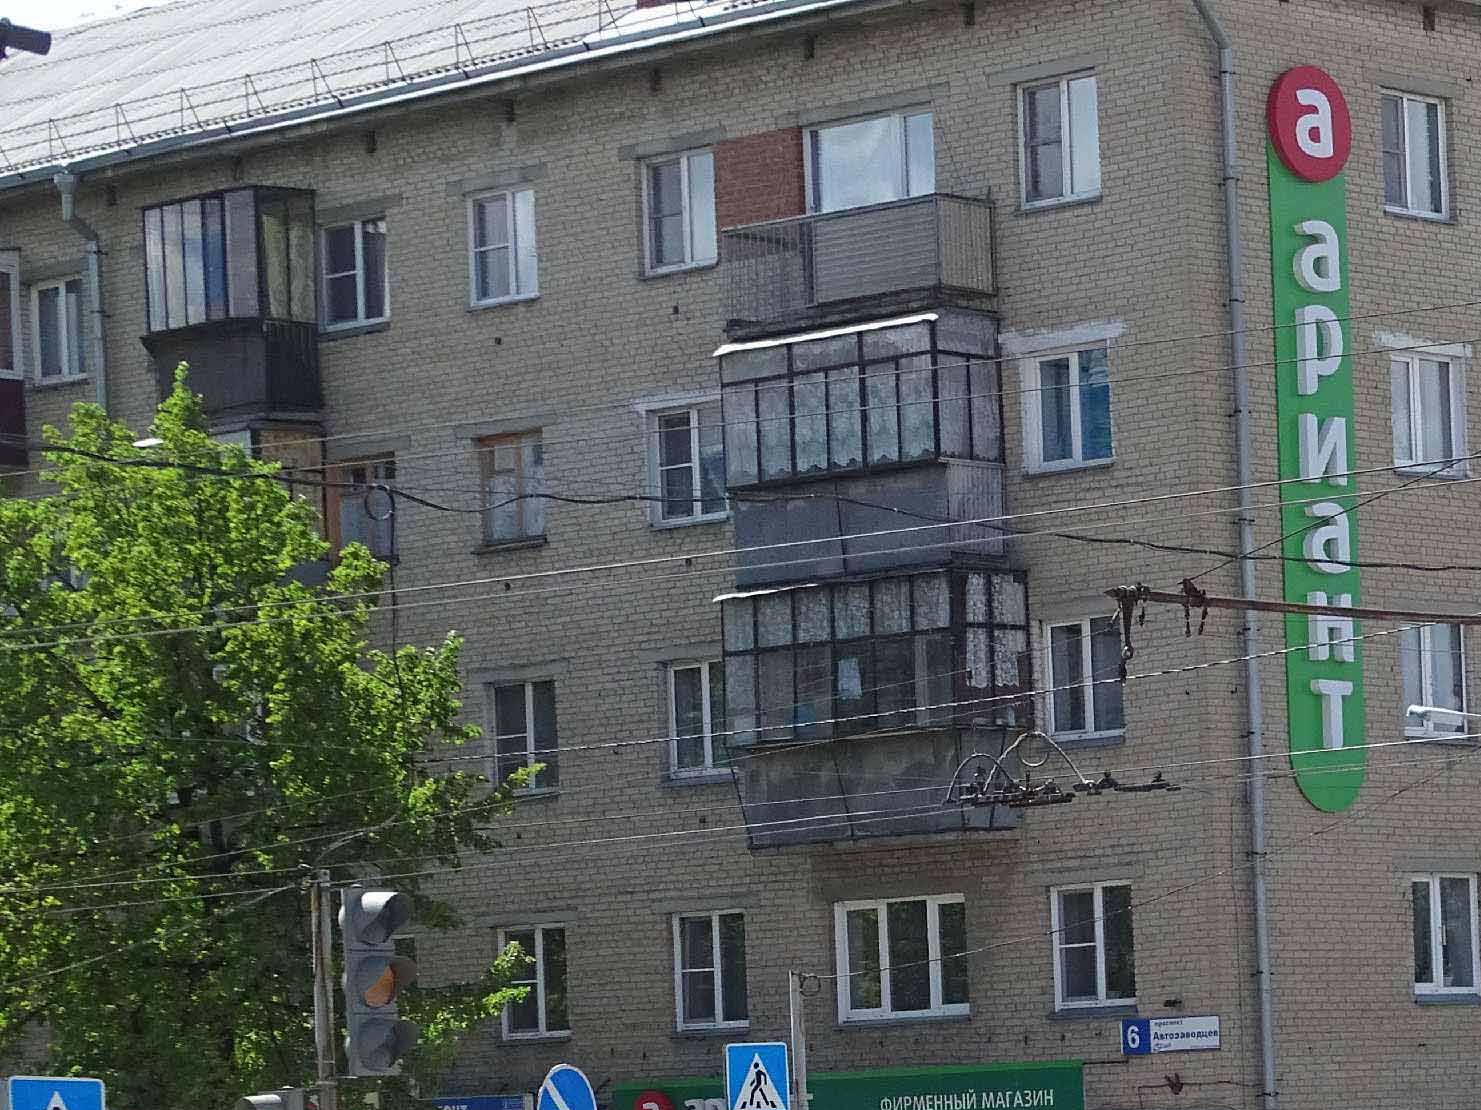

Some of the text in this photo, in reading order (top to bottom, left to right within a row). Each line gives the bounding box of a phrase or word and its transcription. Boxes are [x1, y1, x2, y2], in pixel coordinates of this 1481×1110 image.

[1127, 1025, 1140, 1049] 6
[1153, 1030, 1219, 1041] Автозаводцев
[981, 1089, 1054, 1109] МАГАЗИН
